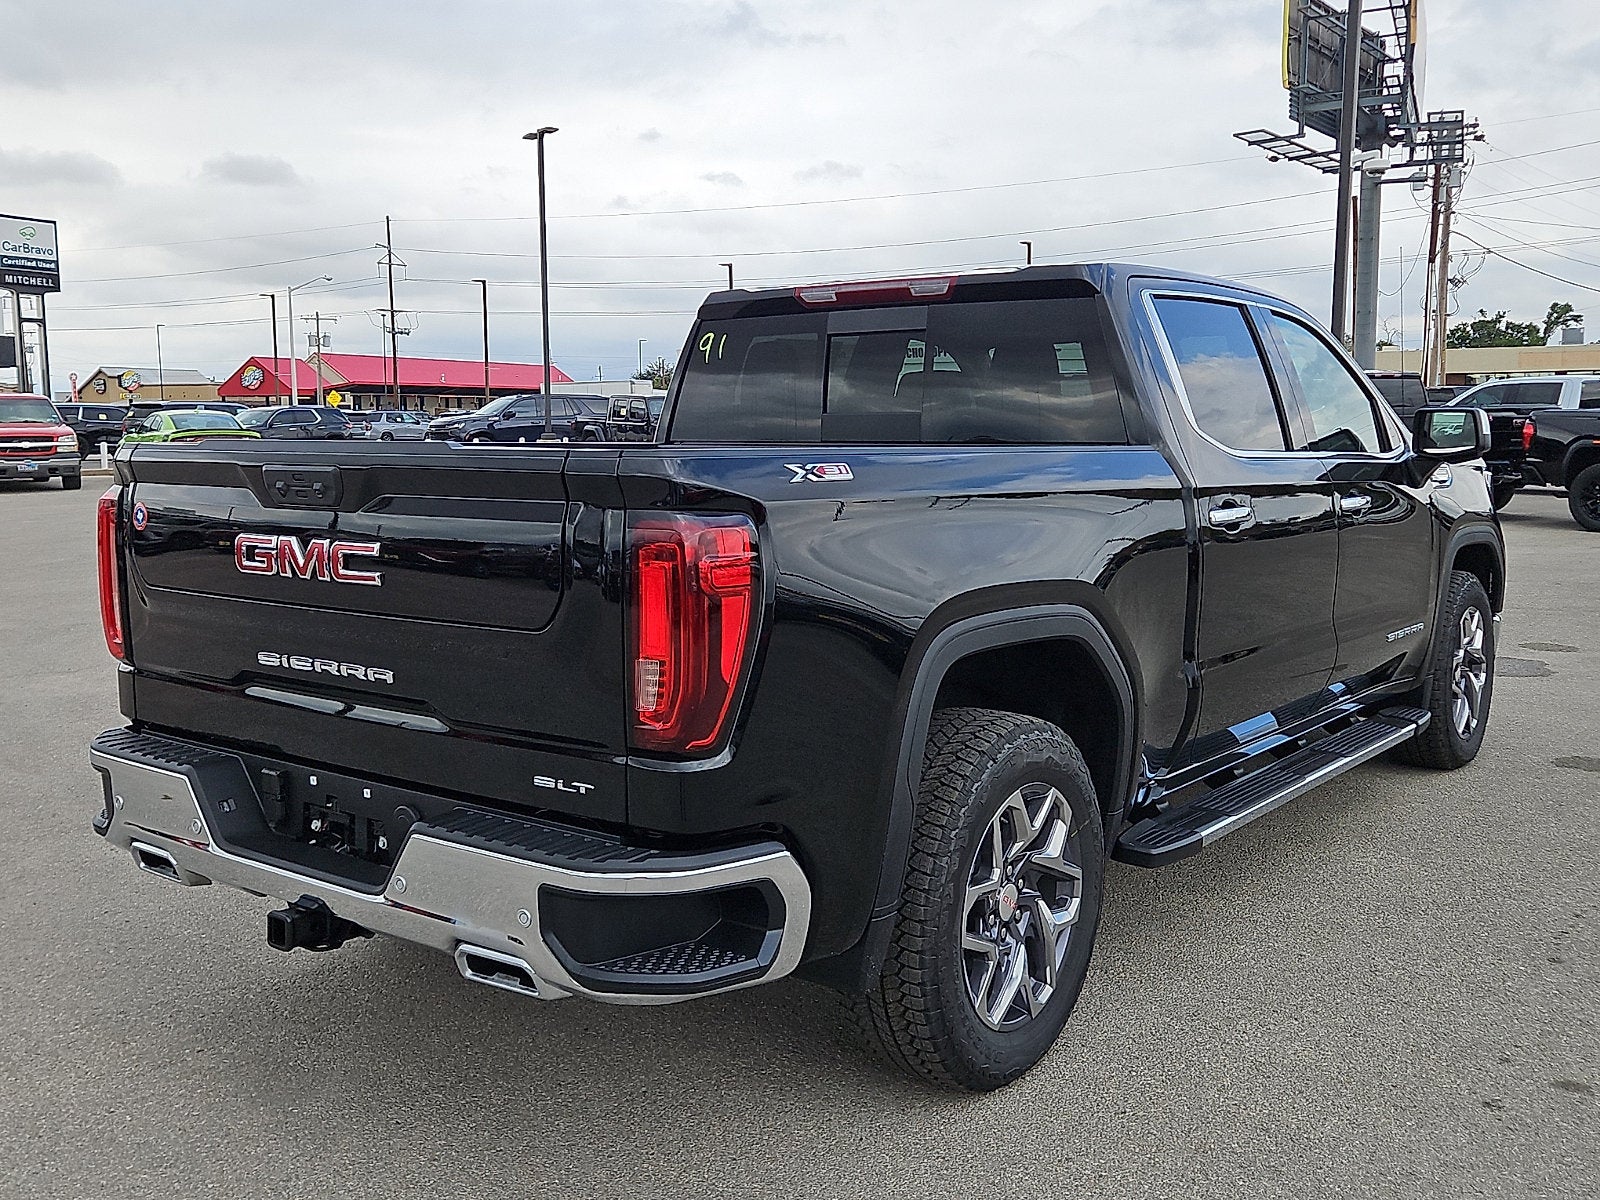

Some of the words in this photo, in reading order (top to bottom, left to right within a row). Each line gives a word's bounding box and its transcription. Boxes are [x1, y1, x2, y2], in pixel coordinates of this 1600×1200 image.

[2, 241, 54, 256] CarBravo
[2, 257, 37, 267] Certified
[37, 260, 56, 269] Used
[5, 274, 56, 287] MITCHELL
[699, 332, 727, 364] 91
[783, 463, 855, 484] X31
[234, 533, 383, 586] GMC
[1386, 622, 1425, 642] SIERRA
[257, 651, 395, 684] SIERRA
[533, 775, 595, 794] SLT
